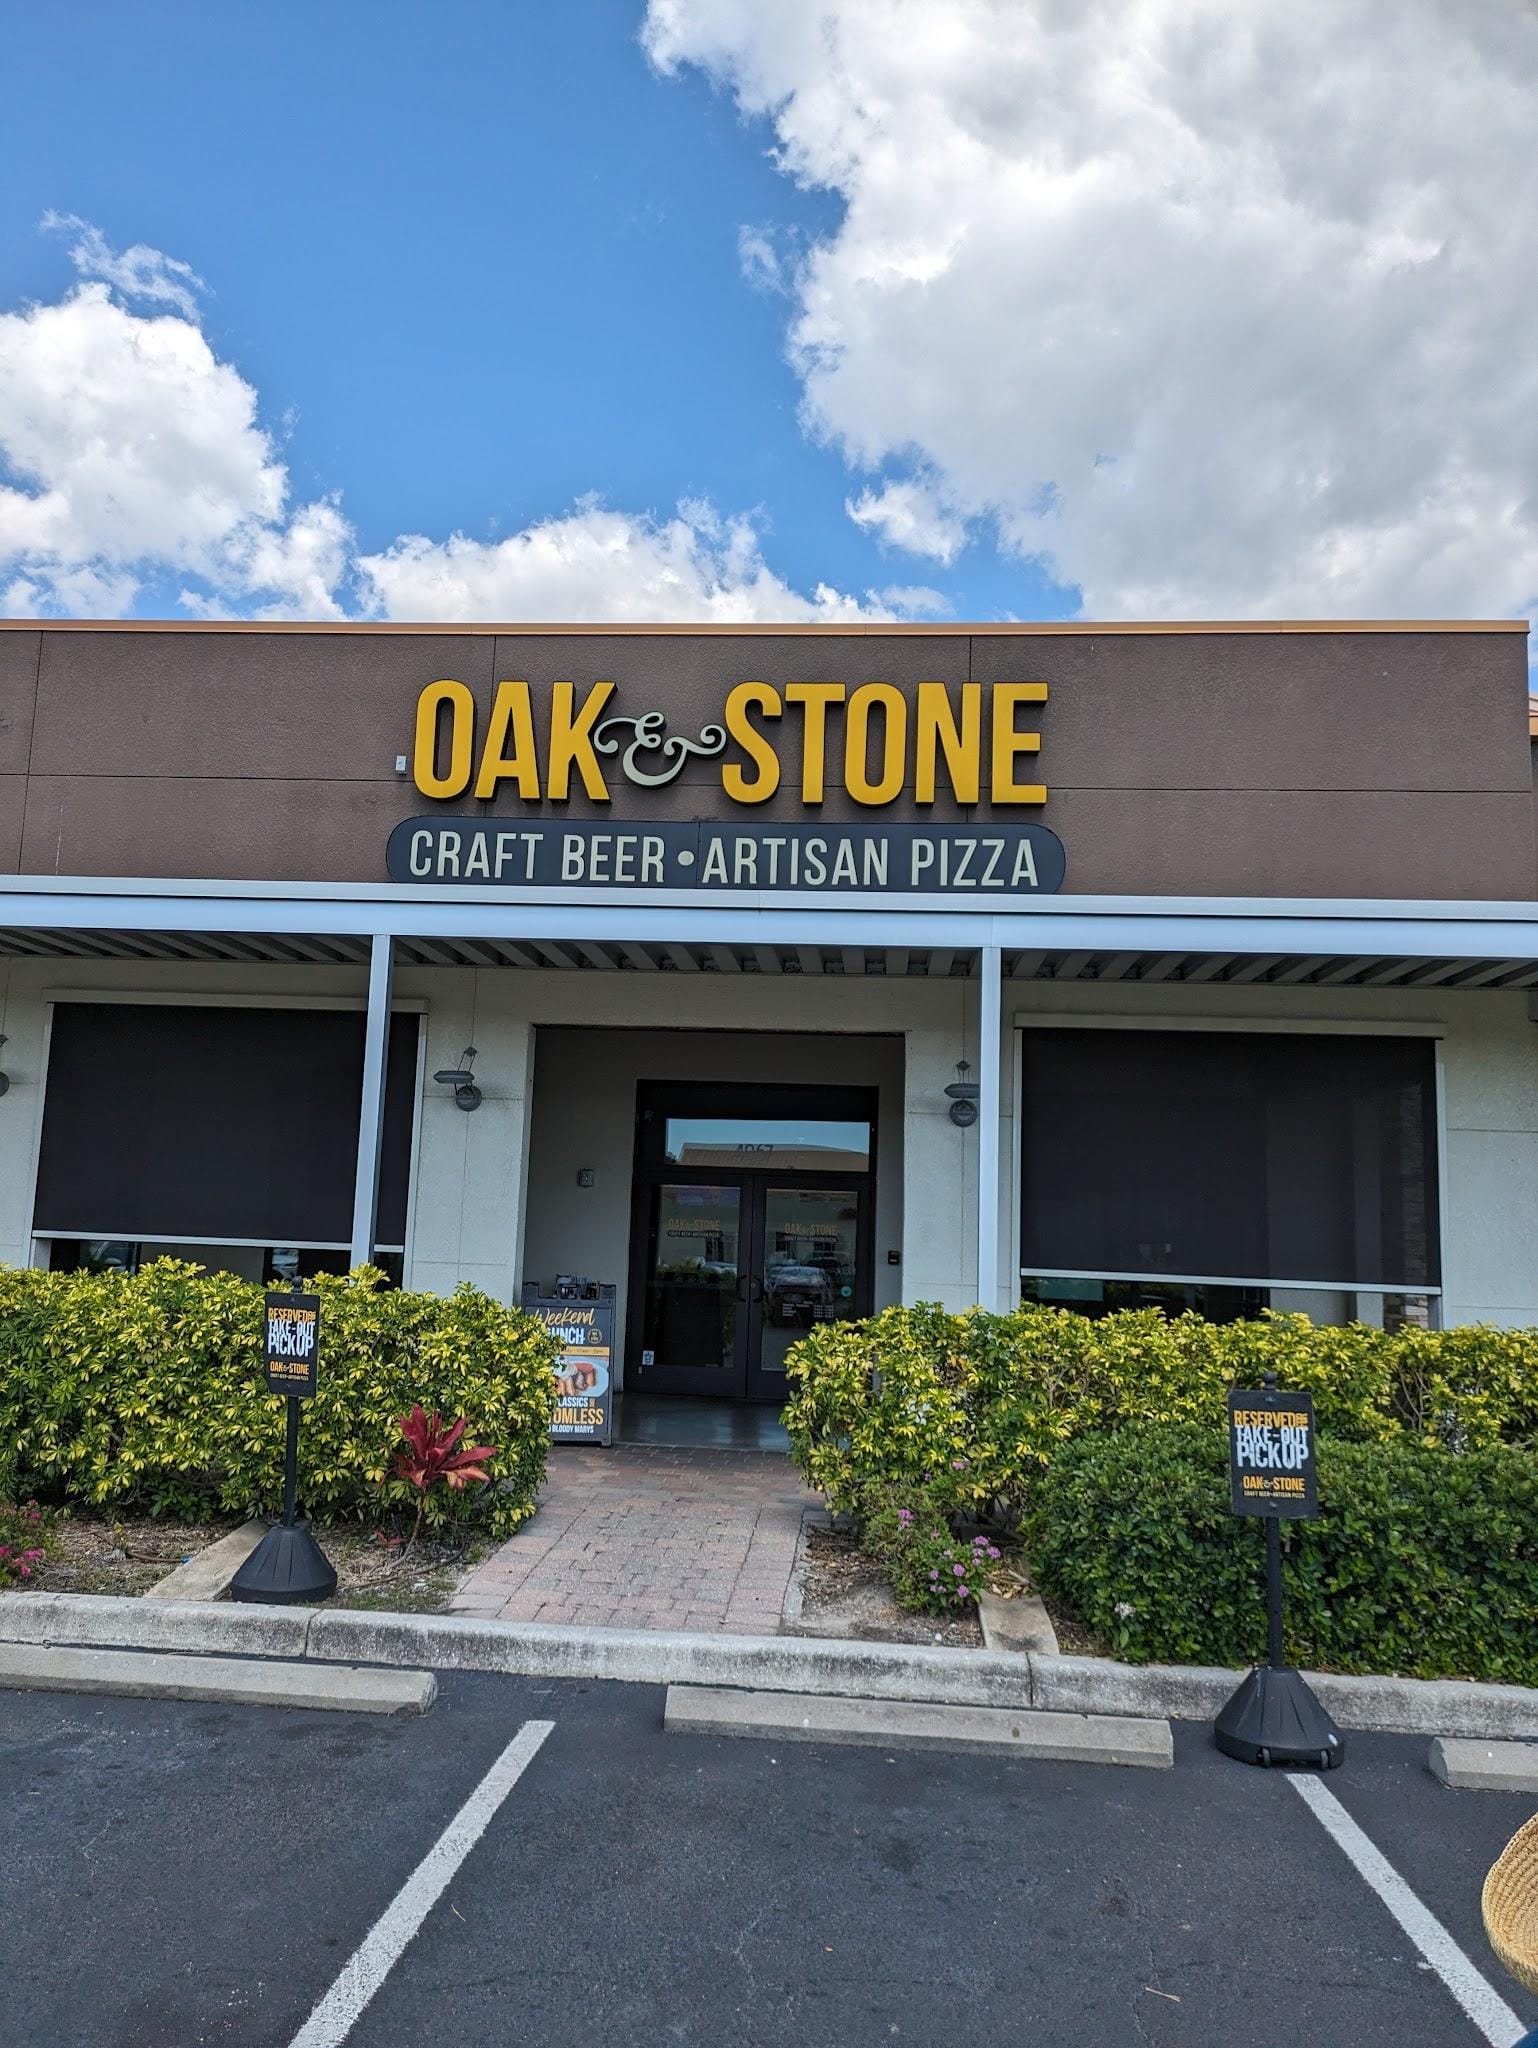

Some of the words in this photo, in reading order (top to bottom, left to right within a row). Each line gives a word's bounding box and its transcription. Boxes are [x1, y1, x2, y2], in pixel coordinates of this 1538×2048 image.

[414, 679, 616, 801] OAK
[594, 711, 728, 788] &
[722, 681, 1049, 806] STONE
[410, 829, 544, 881] CRAFT
[561, 833, 665, 883] BEER
[701, 836, 889, 887] ARTISAN
[911, 838, 1039, 888] PIZZA
[694, 1219, 721, 1231] STONE
[785, 1223, 802, 1234] OAK
[811, 1224, 838, 1236] STONE
[268, 1307, 309, 1323] RESERVED
[268, 1320, 316, 1337] TAKE-OUT
[268, 1333, 315, 1357] PICKUP
[270, 1361, 284, 1373] OAK
[288, 1362, 310, 1375] STONE
[1234, 1410, 1296, 1427] RESERVED
[552, 1424, 573, 1433] BLOODY
[574, 1425, 594, 1433] MARYS
[1234, 1424, 1309, 1445] TAKE-OUT
[1236, 1441, 1309, 1470] PICKUP
[1243, 1475, 1264, 1490] OAK
[1273, 1477, 1306, 1491] STONE
